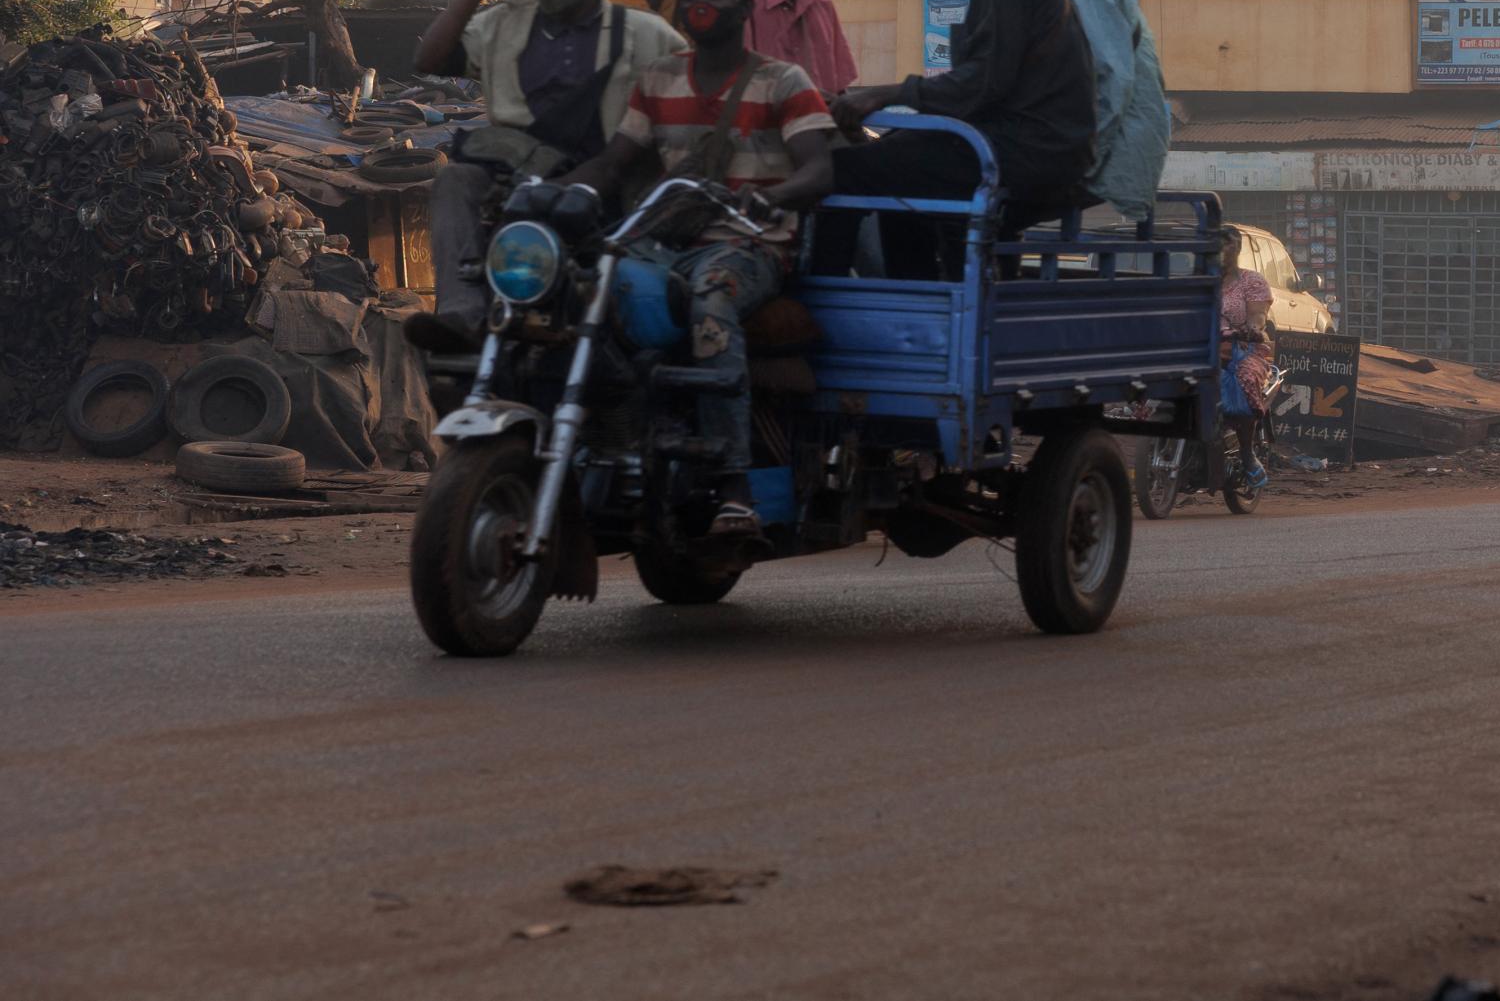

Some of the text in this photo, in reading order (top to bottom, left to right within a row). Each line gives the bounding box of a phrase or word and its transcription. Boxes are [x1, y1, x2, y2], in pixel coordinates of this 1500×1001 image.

[1437, 154, 1482, 167] DIABY
[1487, 155, 1497, 167] &
[1320, 340, 1356, 357] Money
[1320, 357, 1354, 376] Retrait
